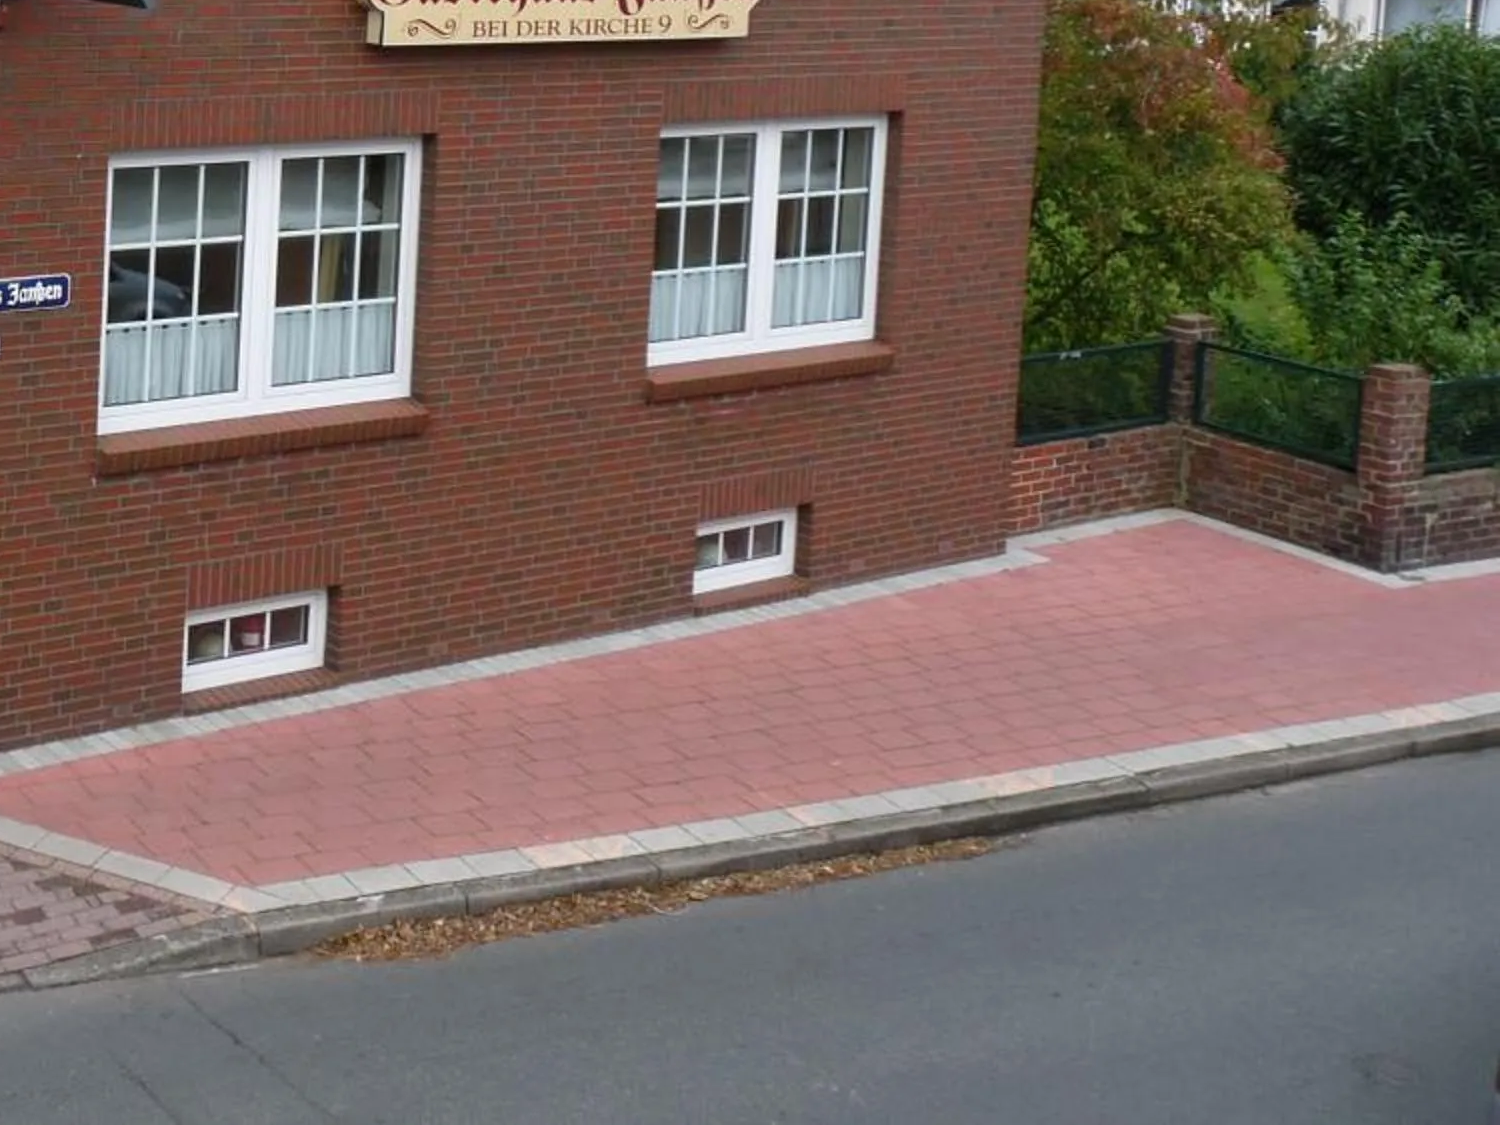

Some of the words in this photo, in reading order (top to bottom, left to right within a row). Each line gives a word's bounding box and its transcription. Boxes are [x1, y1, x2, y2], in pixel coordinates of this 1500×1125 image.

[472, 19, 507, 37] BEI
[517, 18, 561, 36] DER
[569, 17, 652, 36] KIRCHE
[659, 14, 673, 33] 9
